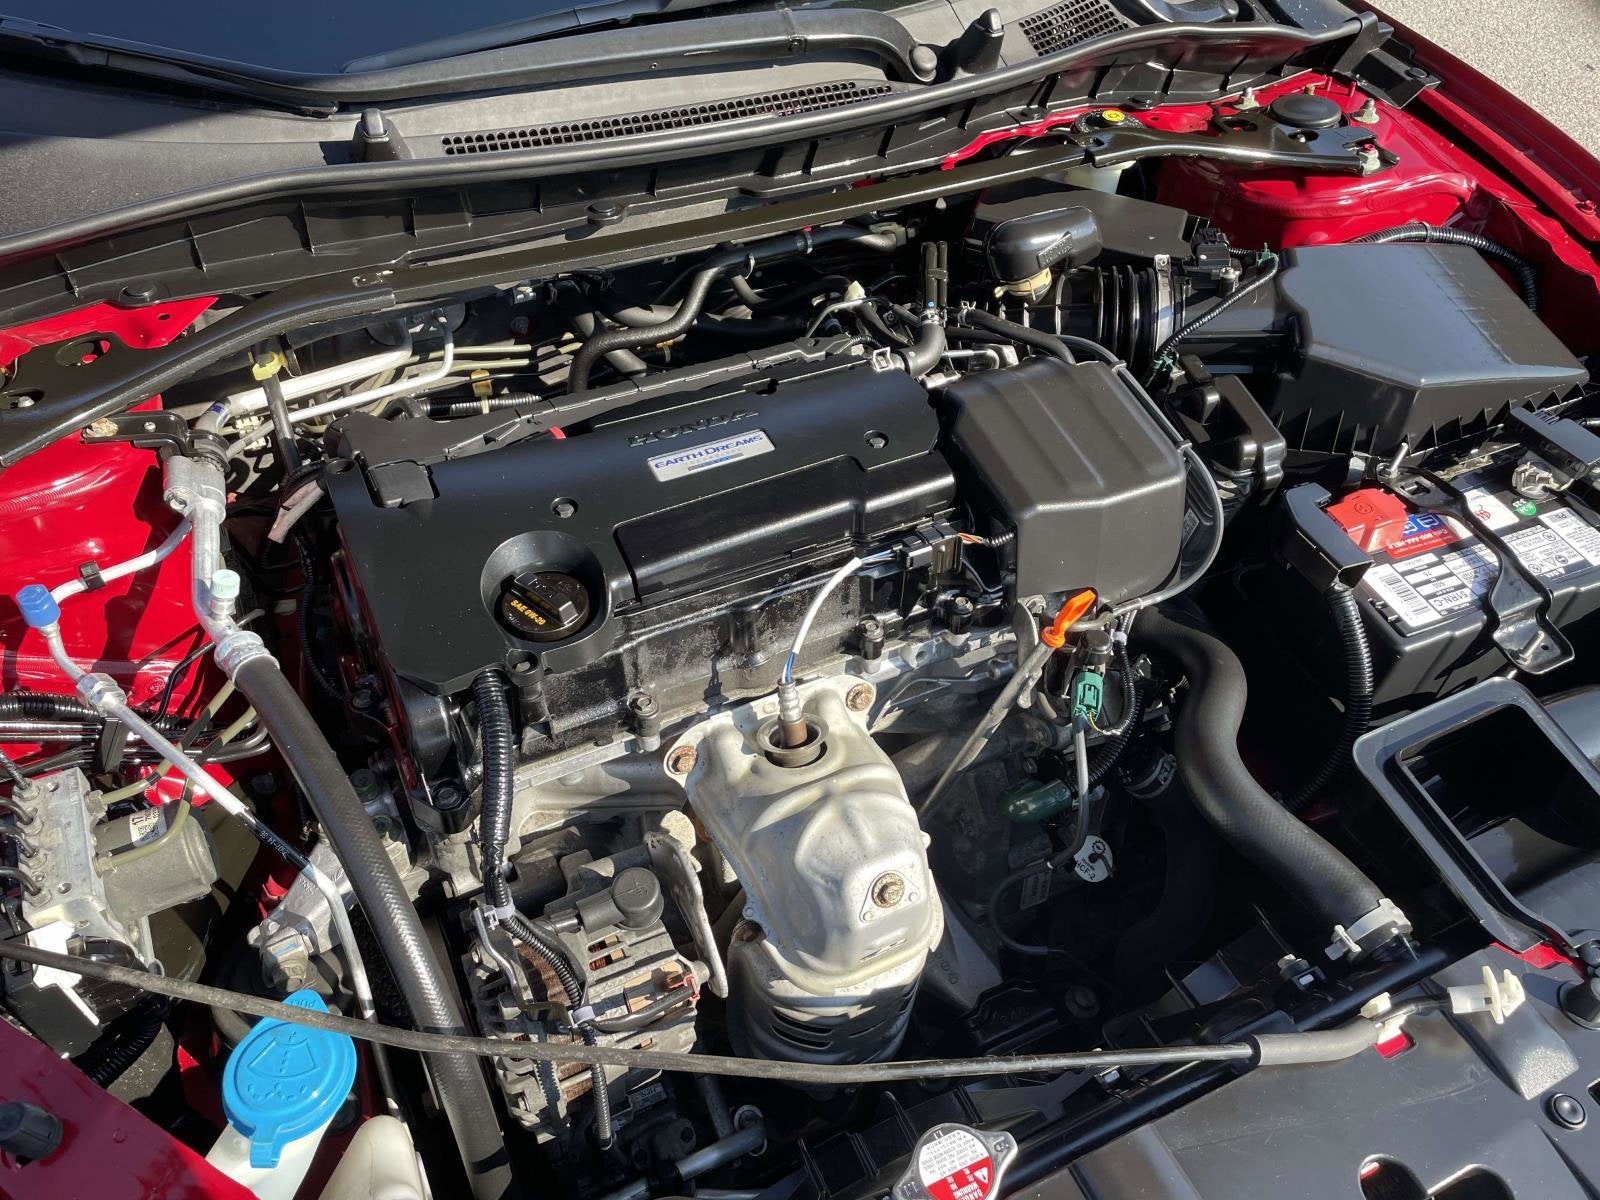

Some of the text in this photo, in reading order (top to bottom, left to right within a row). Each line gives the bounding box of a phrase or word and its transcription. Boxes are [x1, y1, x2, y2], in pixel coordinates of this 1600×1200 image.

[629, 410, 759, 447] HONDA
[654, 450, 704, 469] EARTH
[704, 435, 763, 456] DREAMS
[1433, 590, 1470, 607] 51RN-C
[510, 599, 528, 613] SAE
[524, 609, 546, 626] 0W-20
[131, 811, 145, 825] 17
[959, 1187, 984, 1200] DANGE
